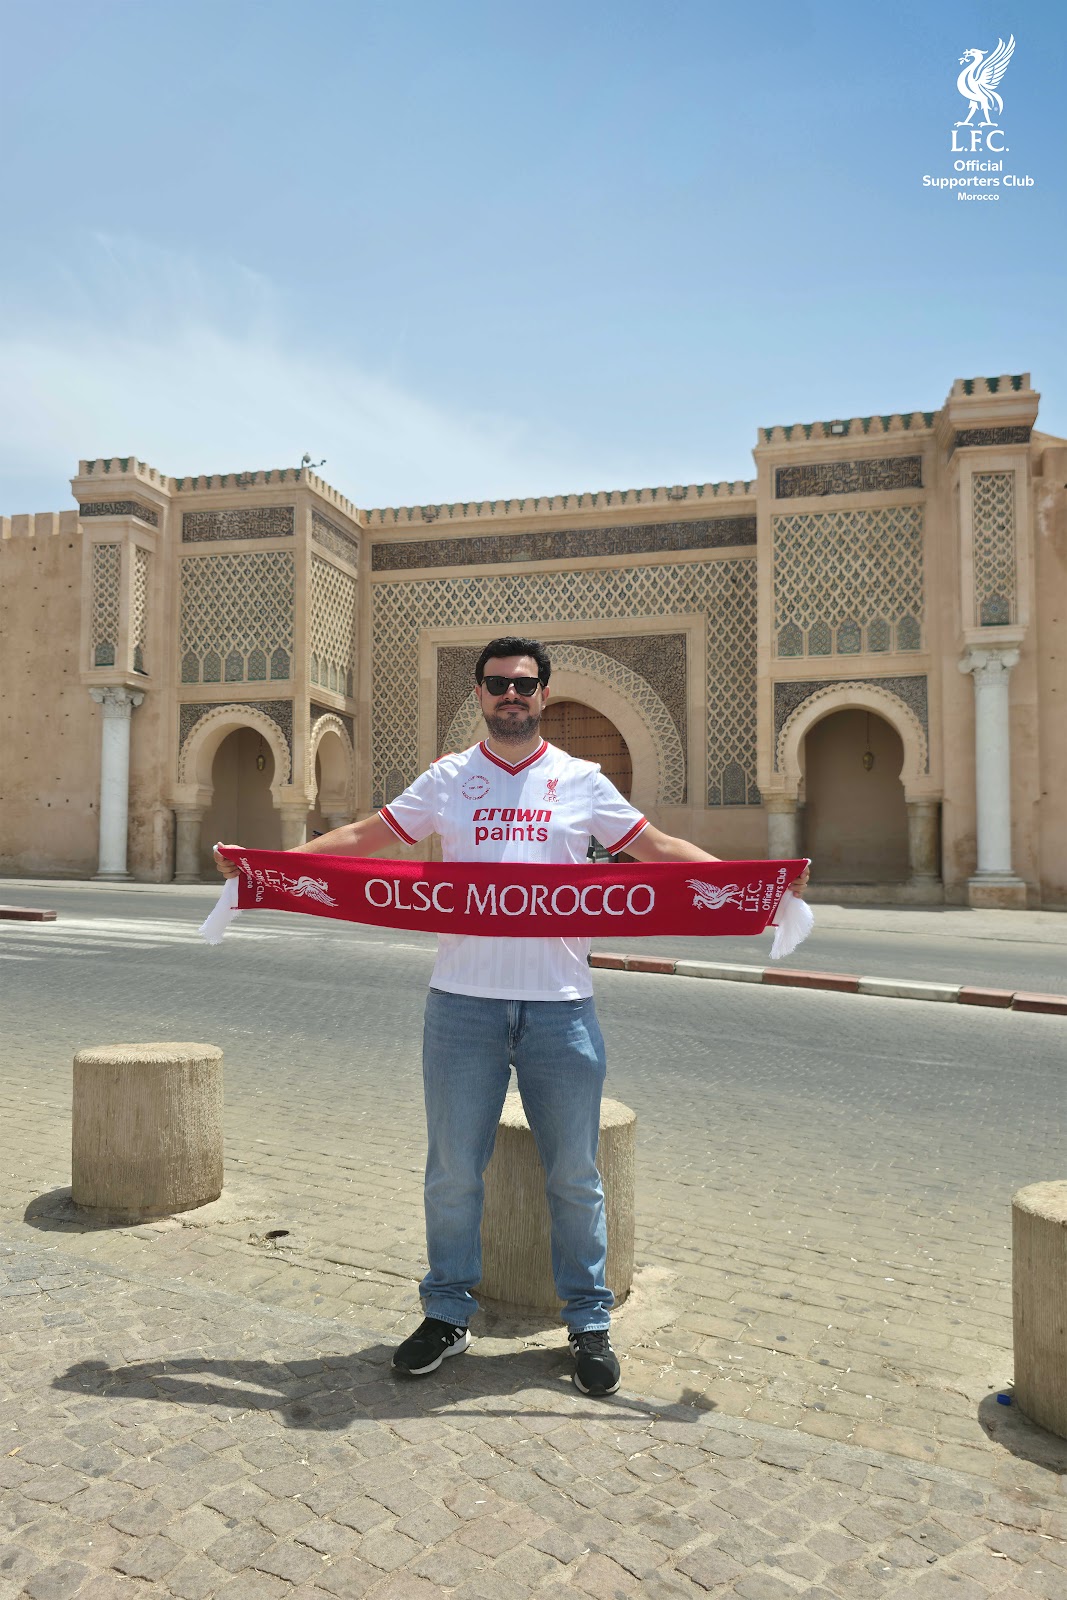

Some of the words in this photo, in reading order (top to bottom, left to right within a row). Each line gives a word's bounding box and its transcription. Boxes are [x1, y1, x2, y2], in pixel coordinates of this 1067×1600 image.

[472, 808, 552, 822] crown
[475, 824, 549, 845] paints
[777, 868, 787, 885] Club
[255, 886, 265, 903] Club
[364, 878, 454, 913] OLSC
[464, 883, 656, 916] MOROCCO
[745, 880, 762, 912] L.F.C.
[762, 884, 774, 910] Official
